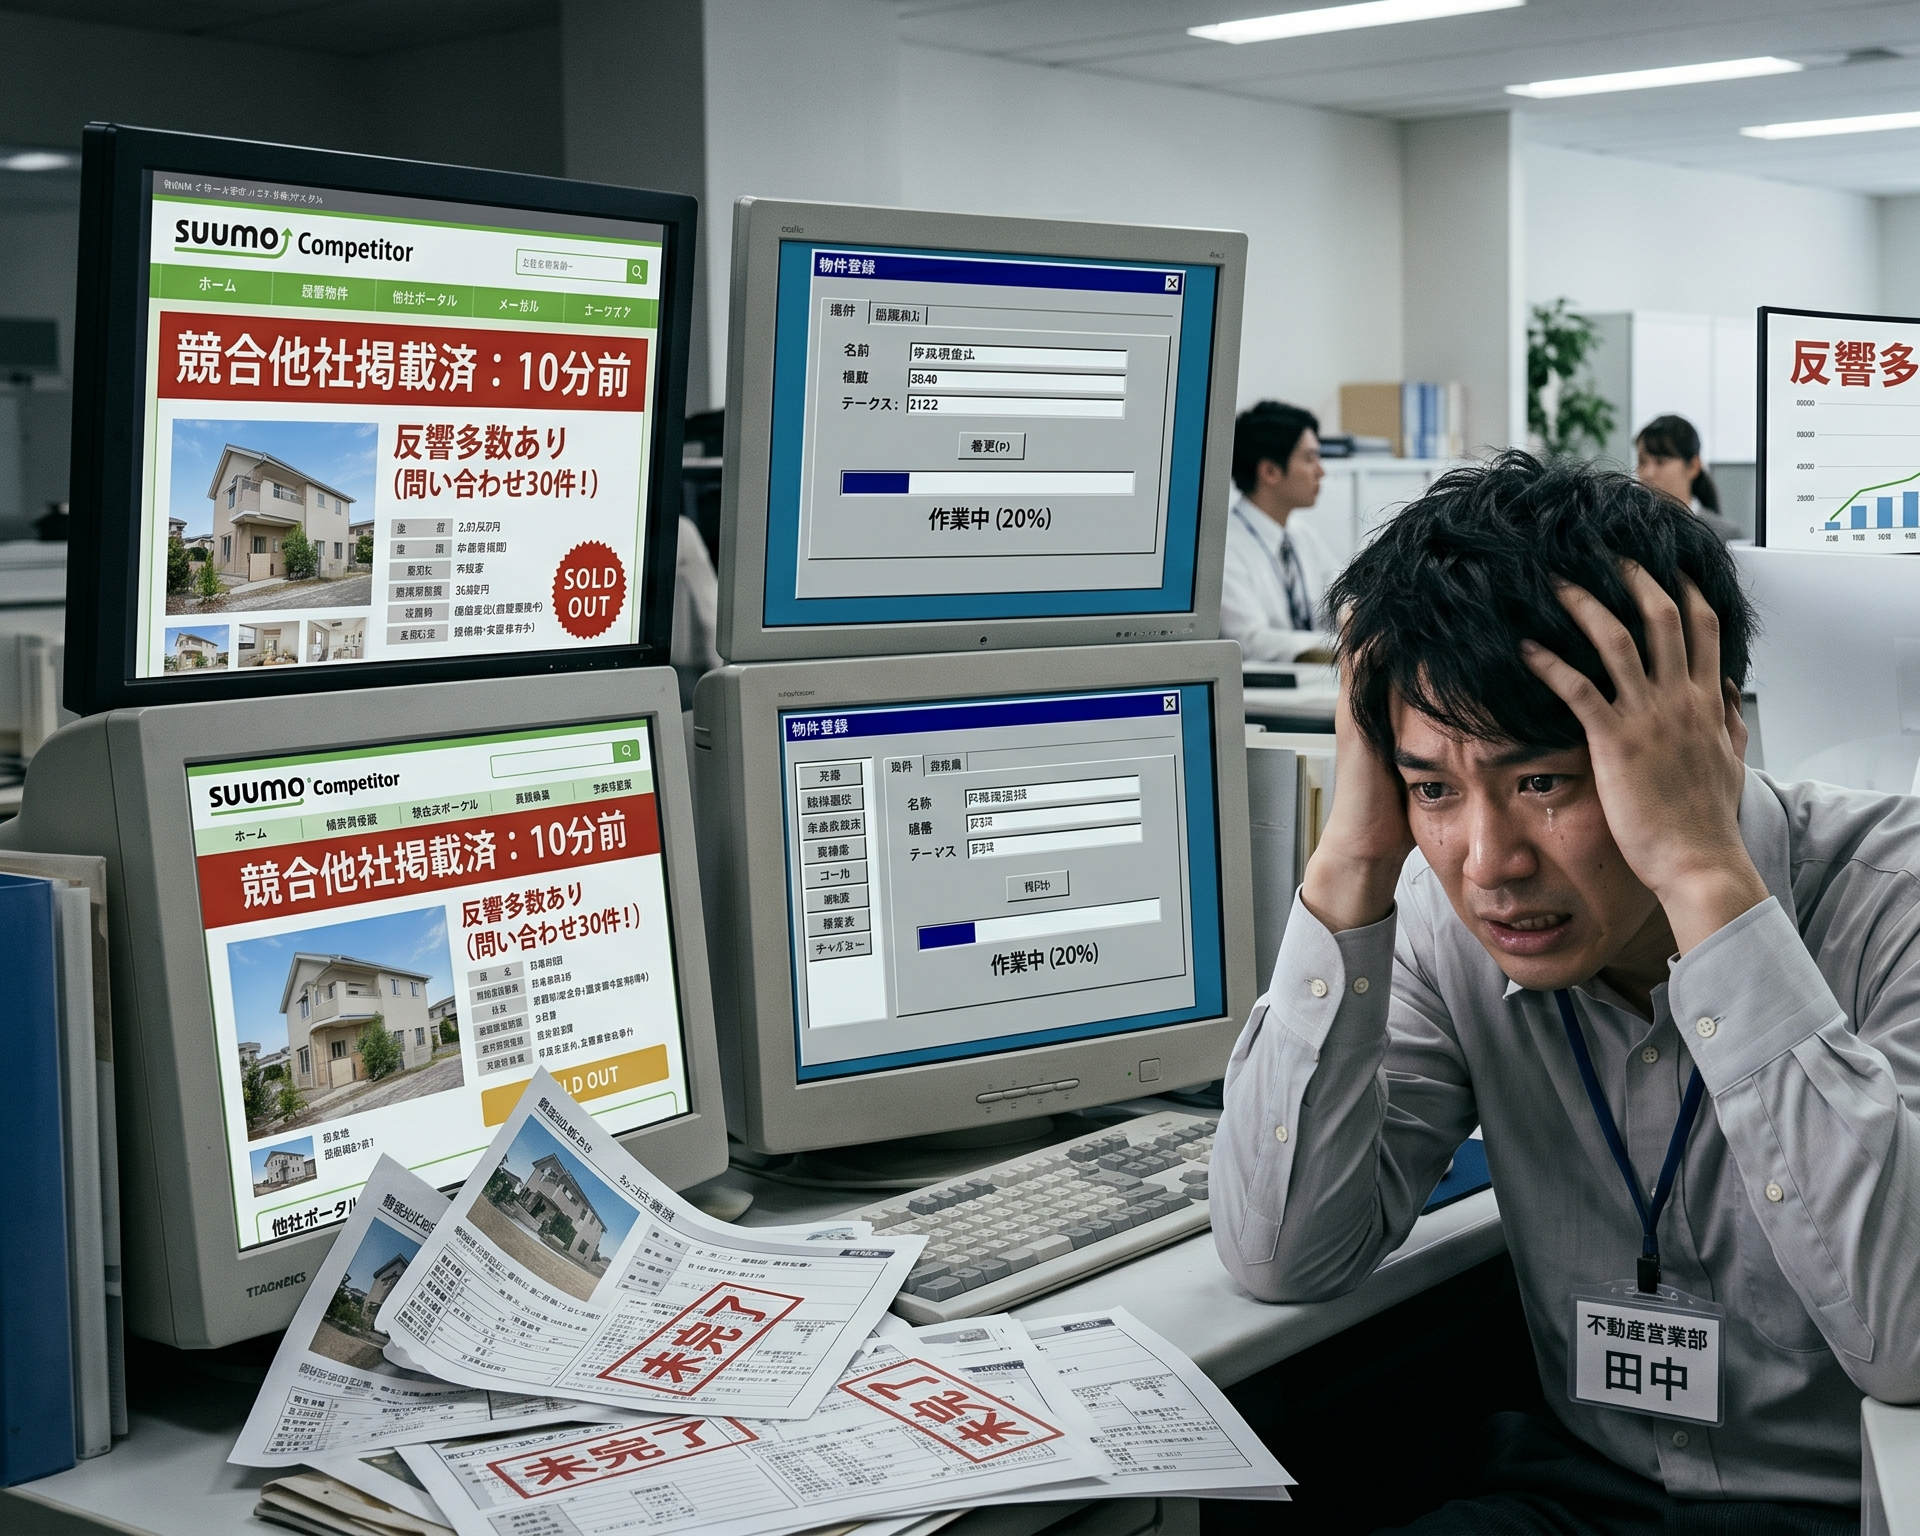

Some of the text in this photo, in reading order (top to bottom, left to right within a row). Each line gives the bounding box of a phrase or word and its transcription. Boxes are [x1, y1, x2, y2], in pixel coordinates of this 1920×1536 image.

[297, 232, 414, 263] Competitor
[199, 277, 236, 292] ホーム
[1790, 340, 1920, 388] 反響多
[909, 399, 939, 411] 2122
[393, 423, 566, 461] 反響多数あり
[928, 507, 1052, 531] 作業中 (20%)
[563, 567, 617, 590] SOLD
[568, 595, 611, 618] OUT
[313, 772, 400, 796] Competitor
[234, 827, 268, 842] ホーム
[462, 882, 583, 928] 反響多数あり
[991, 942, 1099, 977] 作業中 (20%)
[557, 1065, 619, 1096] LD OUT
[639, 1295, 767, 1384] 未完了
[1587, 1313, 1708, 1351] 不動産営業部
[1605, 1350, 1688, 1401] 田中
[867, 1375, 1030, 1447] 未完了
[523, 1419, 707, 1486] 未完了
